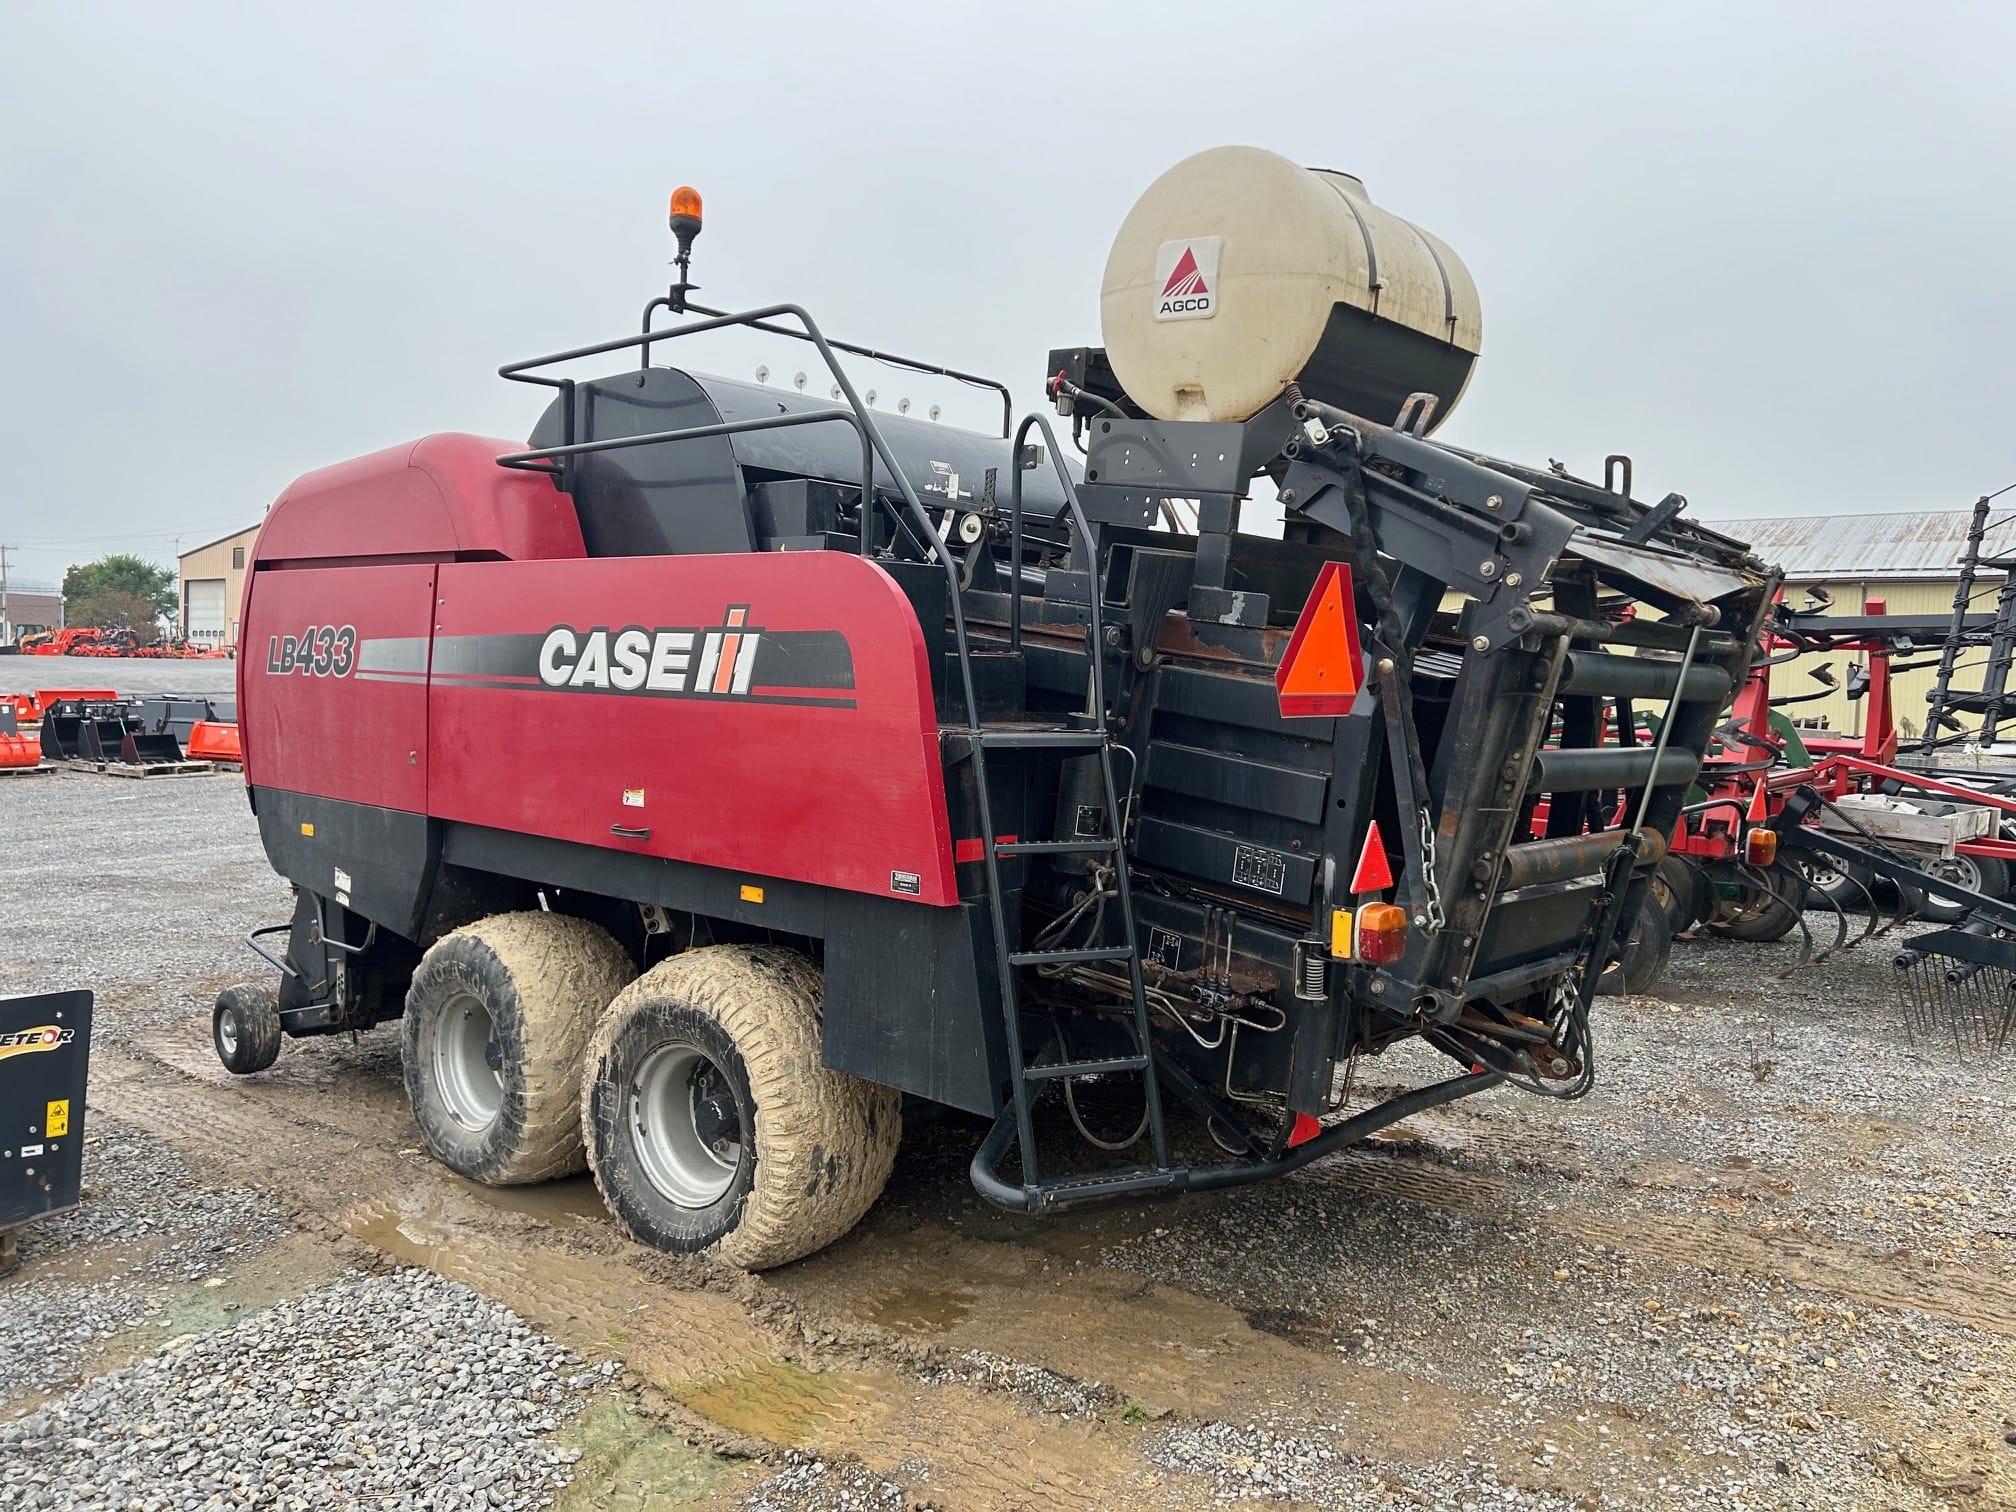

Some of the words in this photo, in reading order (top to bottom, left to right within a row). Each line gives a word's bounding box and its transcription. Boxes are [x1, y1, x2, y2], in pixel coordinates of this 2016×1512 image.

[1160, 298, 1209, 313] AGCO
[266, 624, 356, 678] LB433
[539, 628, 696, 692] CASE
[694, 608, 761, 695] IH
[0, 1028, 75, 1046] ETEOR
